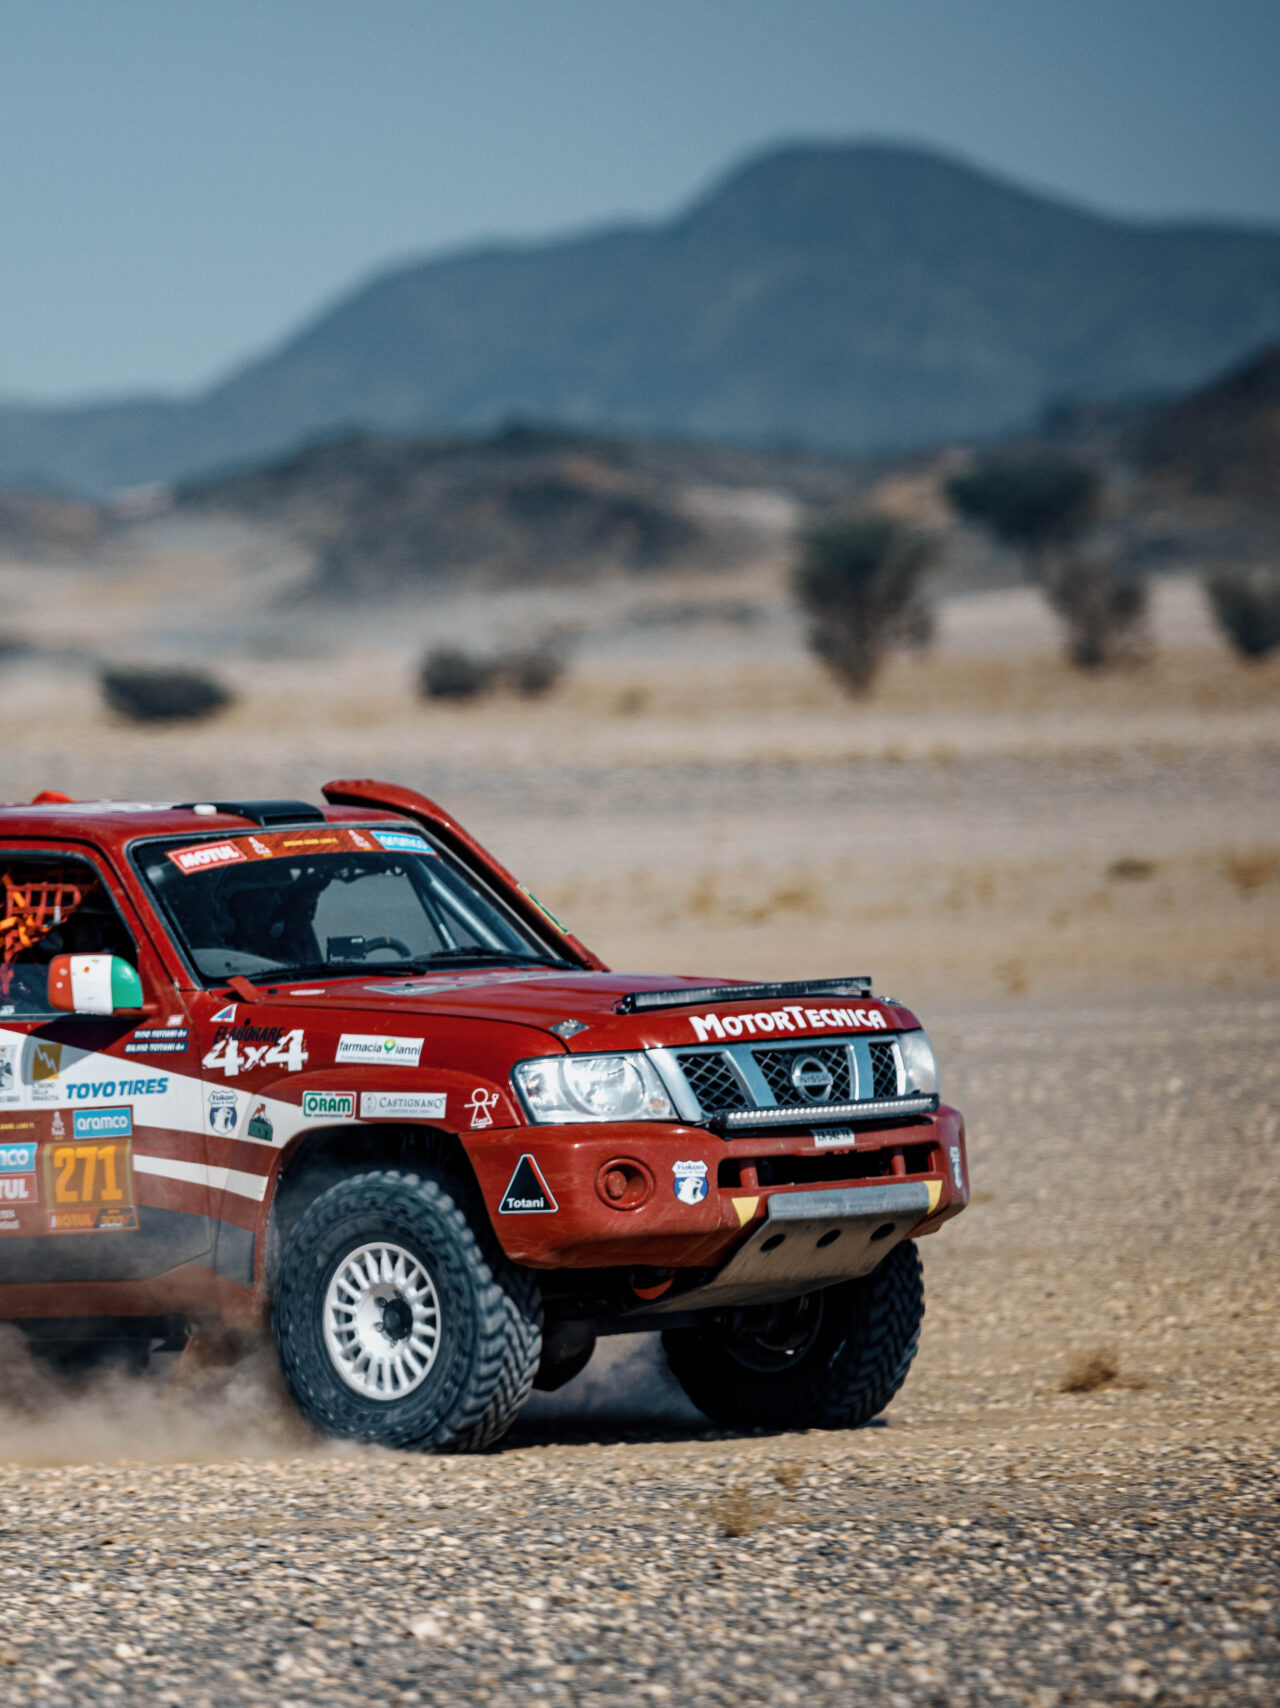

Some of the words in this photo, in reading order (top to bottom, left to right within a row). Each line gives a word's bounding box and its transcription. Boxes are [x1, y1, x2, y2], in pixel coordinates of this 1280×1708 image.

[178, 842, 240, 868] MOTUL
[201, 1029, 309, 1077] 4x4
[339, 1040, 382, 1053] farmacia
[66, 1083, 119, 1100] TOYO
[119, 1077, 169, 1097] TIRES
[307, 1097, 351, 1112] ORAM
[379, 1097, 443, 1109] CASTIGNANO
[76, 1115, 128, 1130] aramco
[53, 1145, 123, 1204] 271
[507, 1197, 544, 1209] Totani
[51, 1214, 93, 1228] MOTUL
